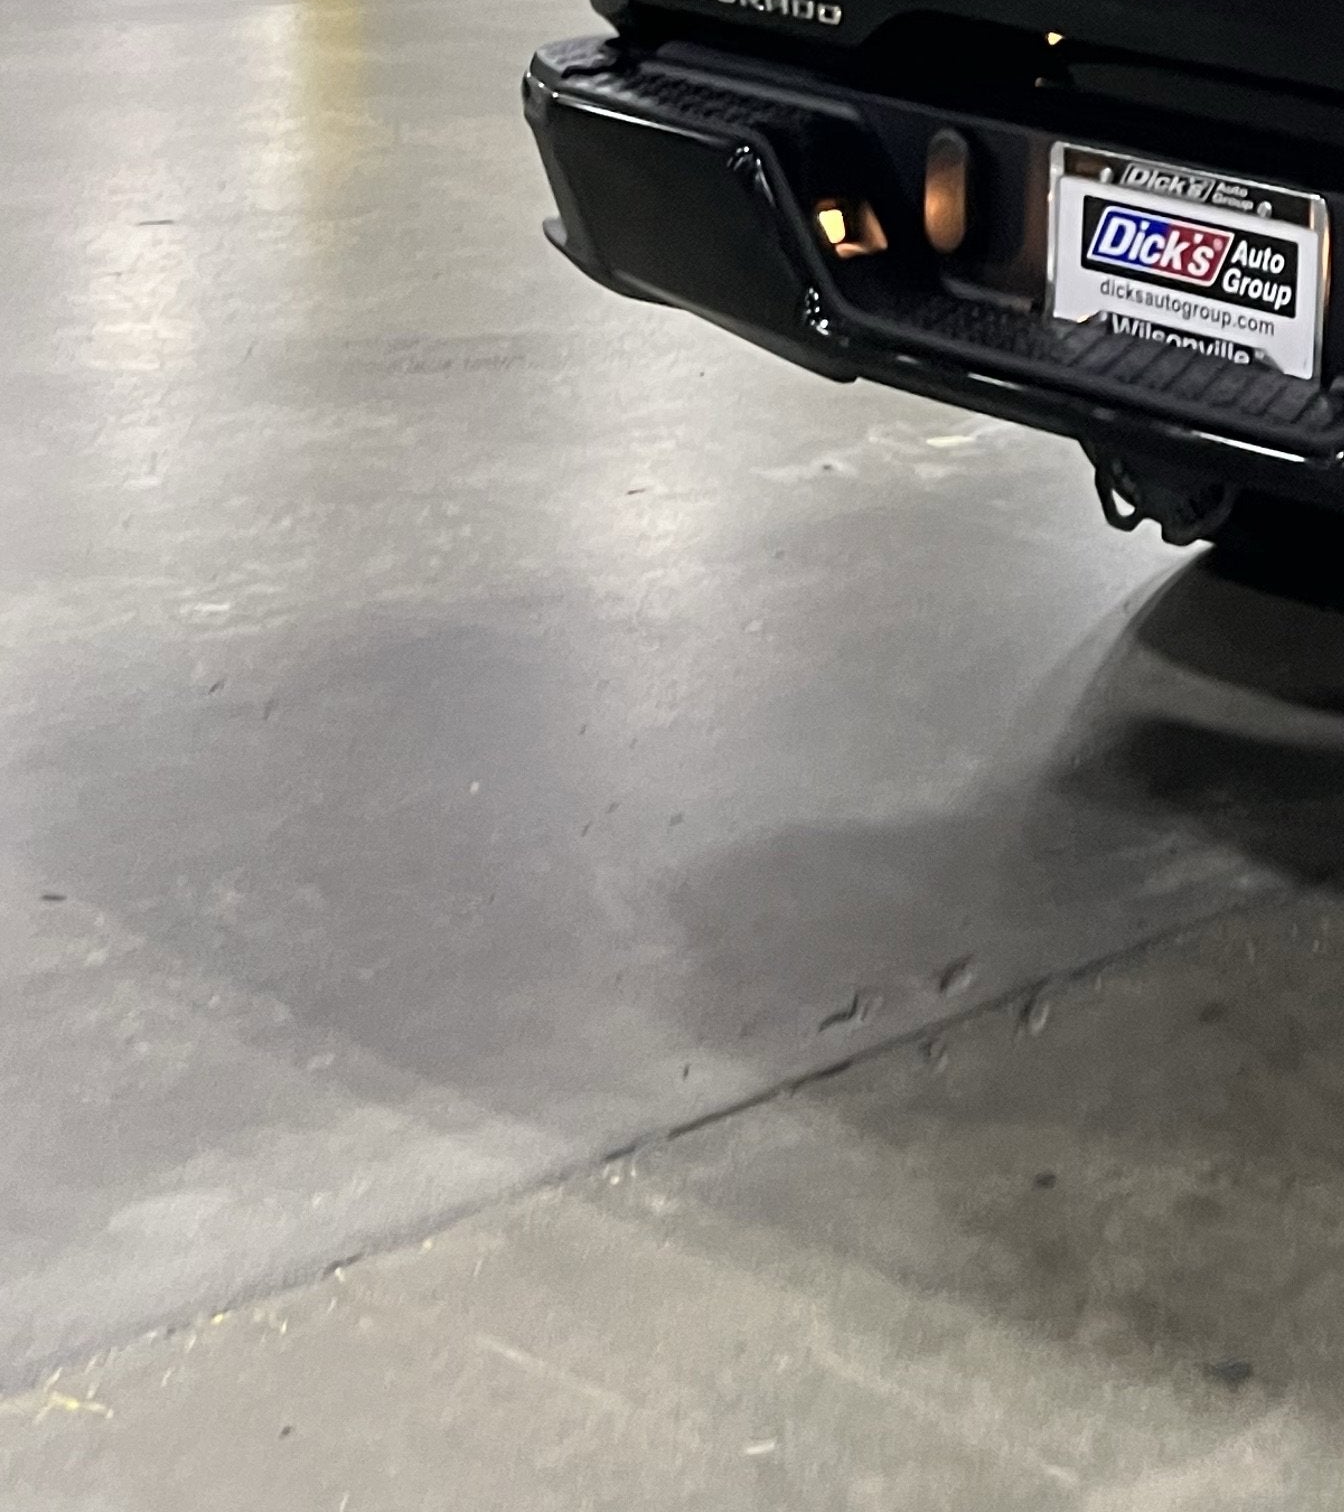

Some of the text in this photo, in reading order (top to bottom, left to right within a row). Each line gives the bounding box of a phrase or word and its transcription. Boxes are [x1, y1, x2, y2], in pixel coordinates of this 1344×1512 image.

[1211, 191, 1254, 212] Group
[1216, 182, 1249, 198] Auto
[1231, 239, 1285, 275] Auto
[1100, 278, 1276, 336] dicksautogroup.com
[1222, 267, 1293, 310] Group
[1110, 312, 1251, 365] Wilsonville
